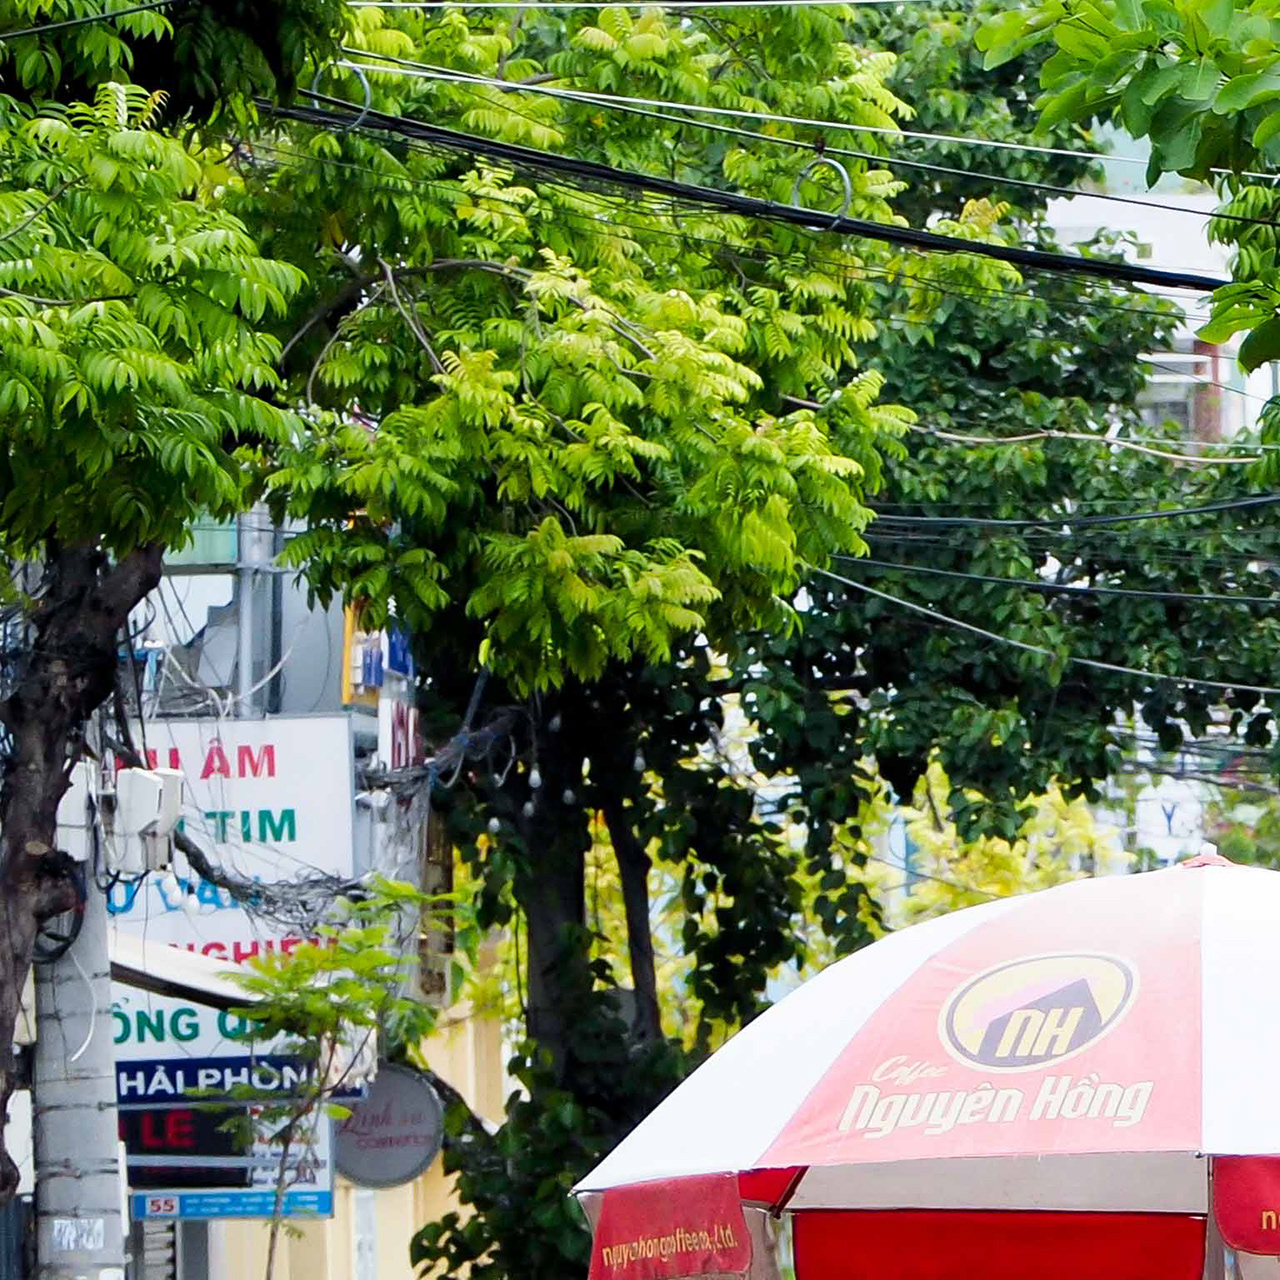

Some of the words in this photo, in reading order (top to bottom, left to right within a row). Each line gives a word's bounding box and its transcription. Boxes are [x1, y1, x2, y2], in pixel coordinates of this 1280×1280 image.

[201, 737, 276, 780] ÂM
[205, 808, 297, 844] TIM
[119, 1065, 185, 1096] HẢI
[1029, 1072, 1155, 1128] Hồng
